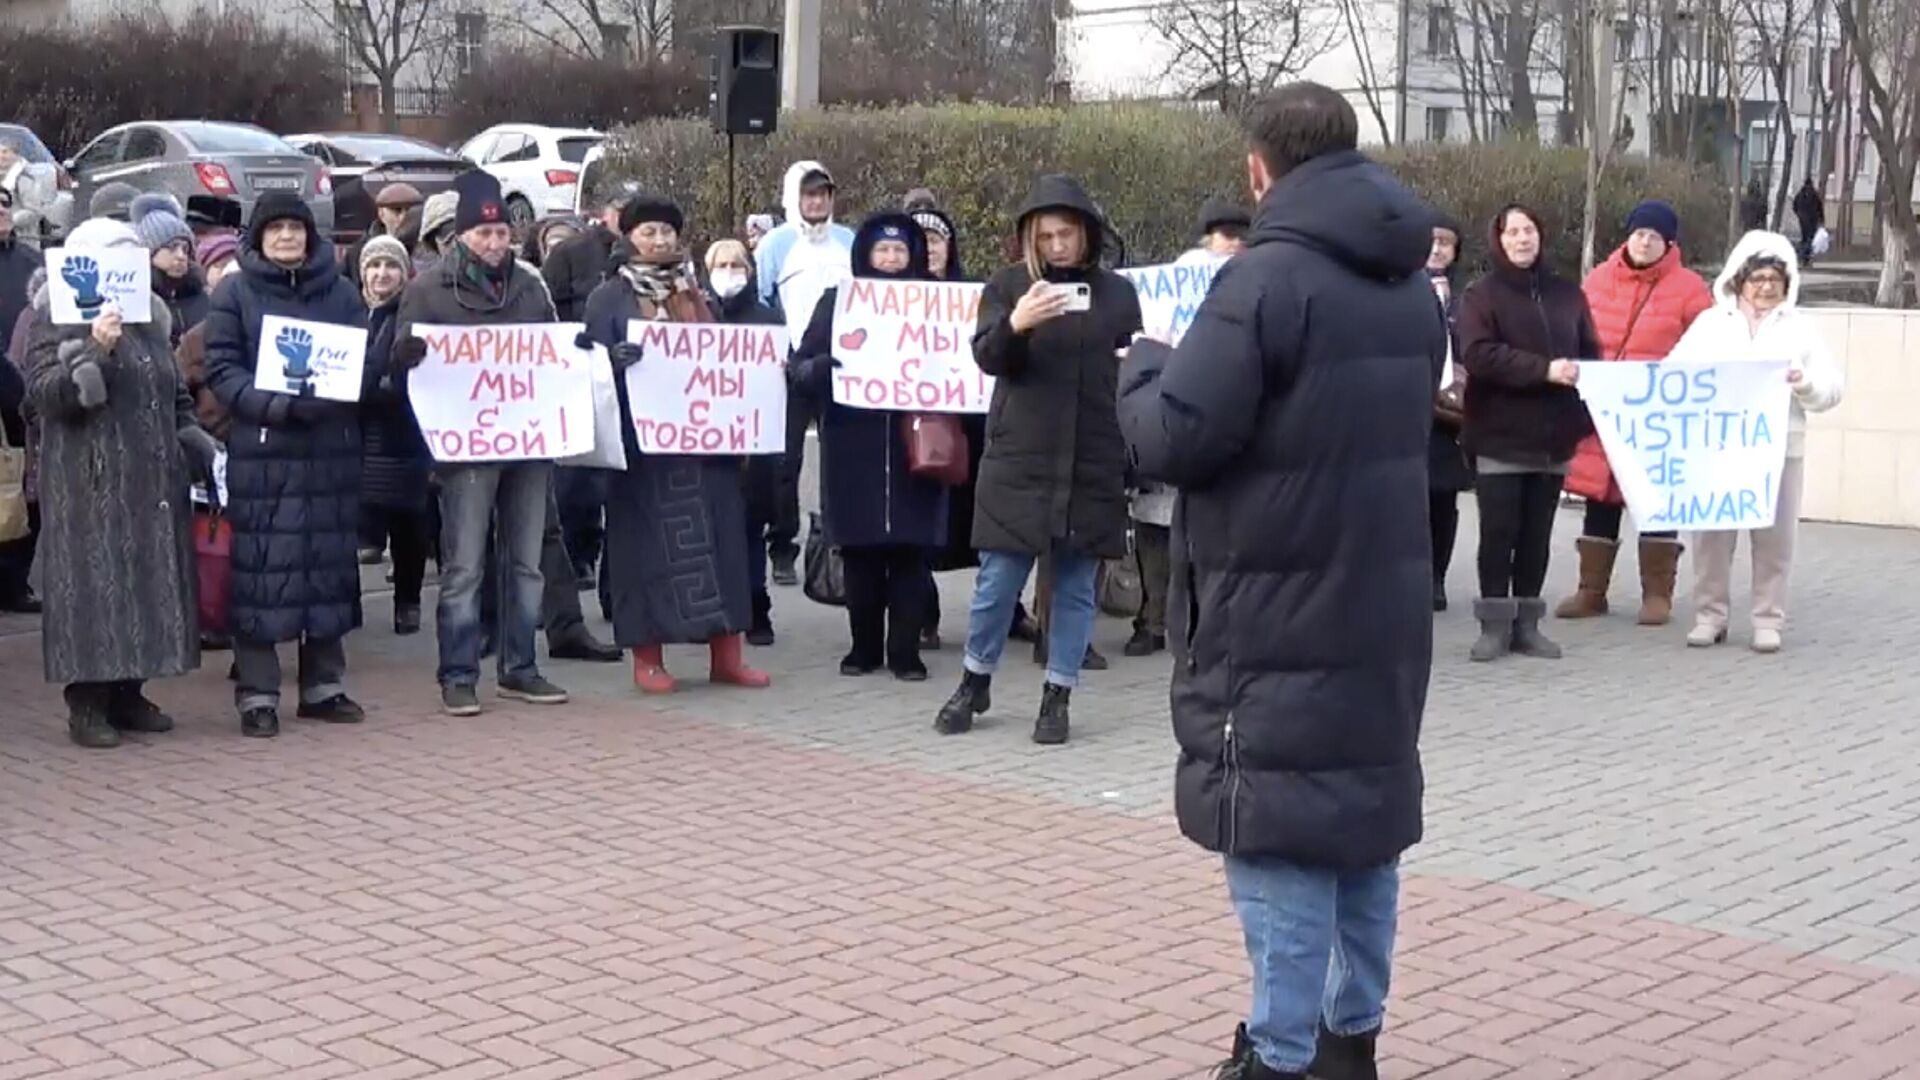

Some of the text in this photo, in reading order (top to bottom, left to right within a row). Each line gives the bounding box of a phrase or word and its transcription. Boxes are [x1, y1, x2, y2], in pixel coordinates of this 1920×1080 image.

[426, 328, 570, 368] МАРИНА,
[897, 321, 958, 353] МЫ
[470, 369, 534, 401] МЫ
[685, 366, 743, 398] МЫ
[838, 368, 983, 407] ТОБОЙ!
[1623, 363, 1717, 405] JOS
[425, 405, 568, 456] ТОБОЙ!
[636, 409, 759, 450] ТОБОЙ!
